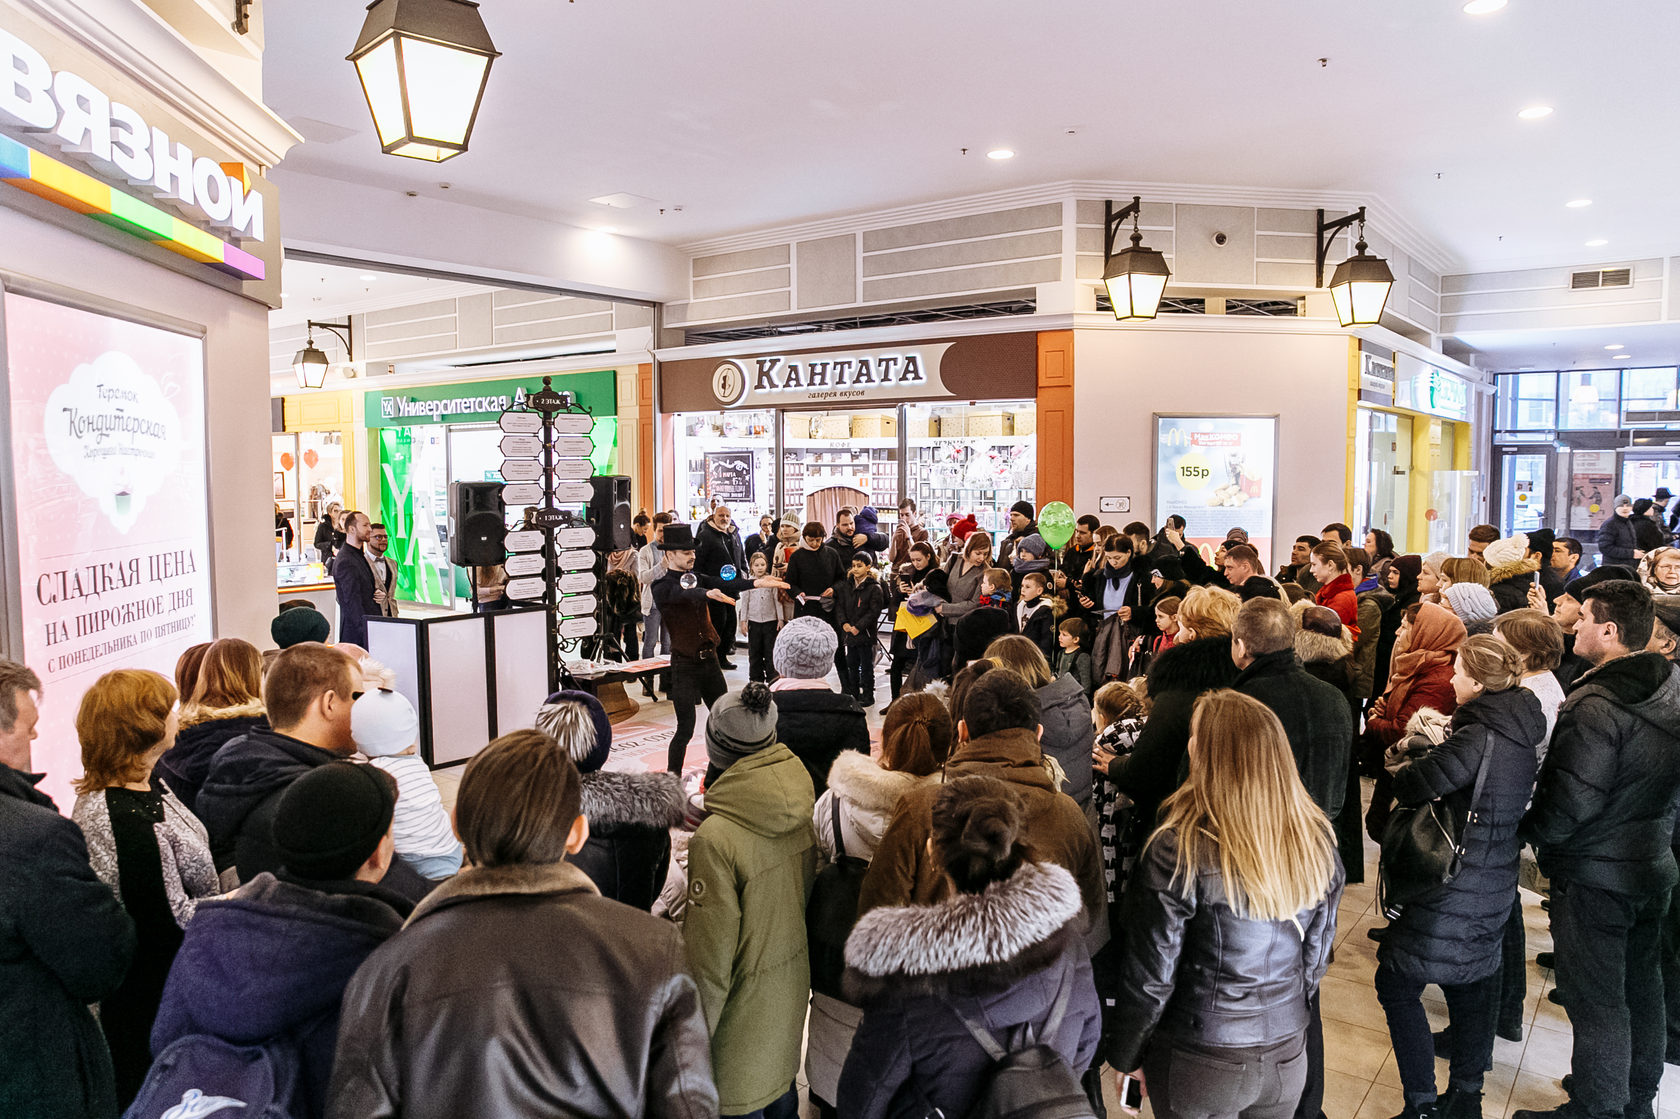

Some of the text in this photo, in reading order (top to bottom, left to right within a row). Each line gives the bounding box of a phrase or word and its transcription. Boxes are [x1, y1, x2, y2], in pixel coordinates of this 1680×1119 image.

[396, 395, 506, 421] Университетская
[807, 389, 865, 400] галерея вкусов
[62, 407, 168, 445] Кондитерская
[36, 548, 197, 606] СЛАДКАЯ ЦЕНА
[44, 587, 194, 647] НА ПИРОЖНОЕ ДНЯ
[47, 658, 56, 673] С
[58, 633, 138, 671] ПОНЕДЕЛЬНИКА
[140, 628, 153, 644] ПО
